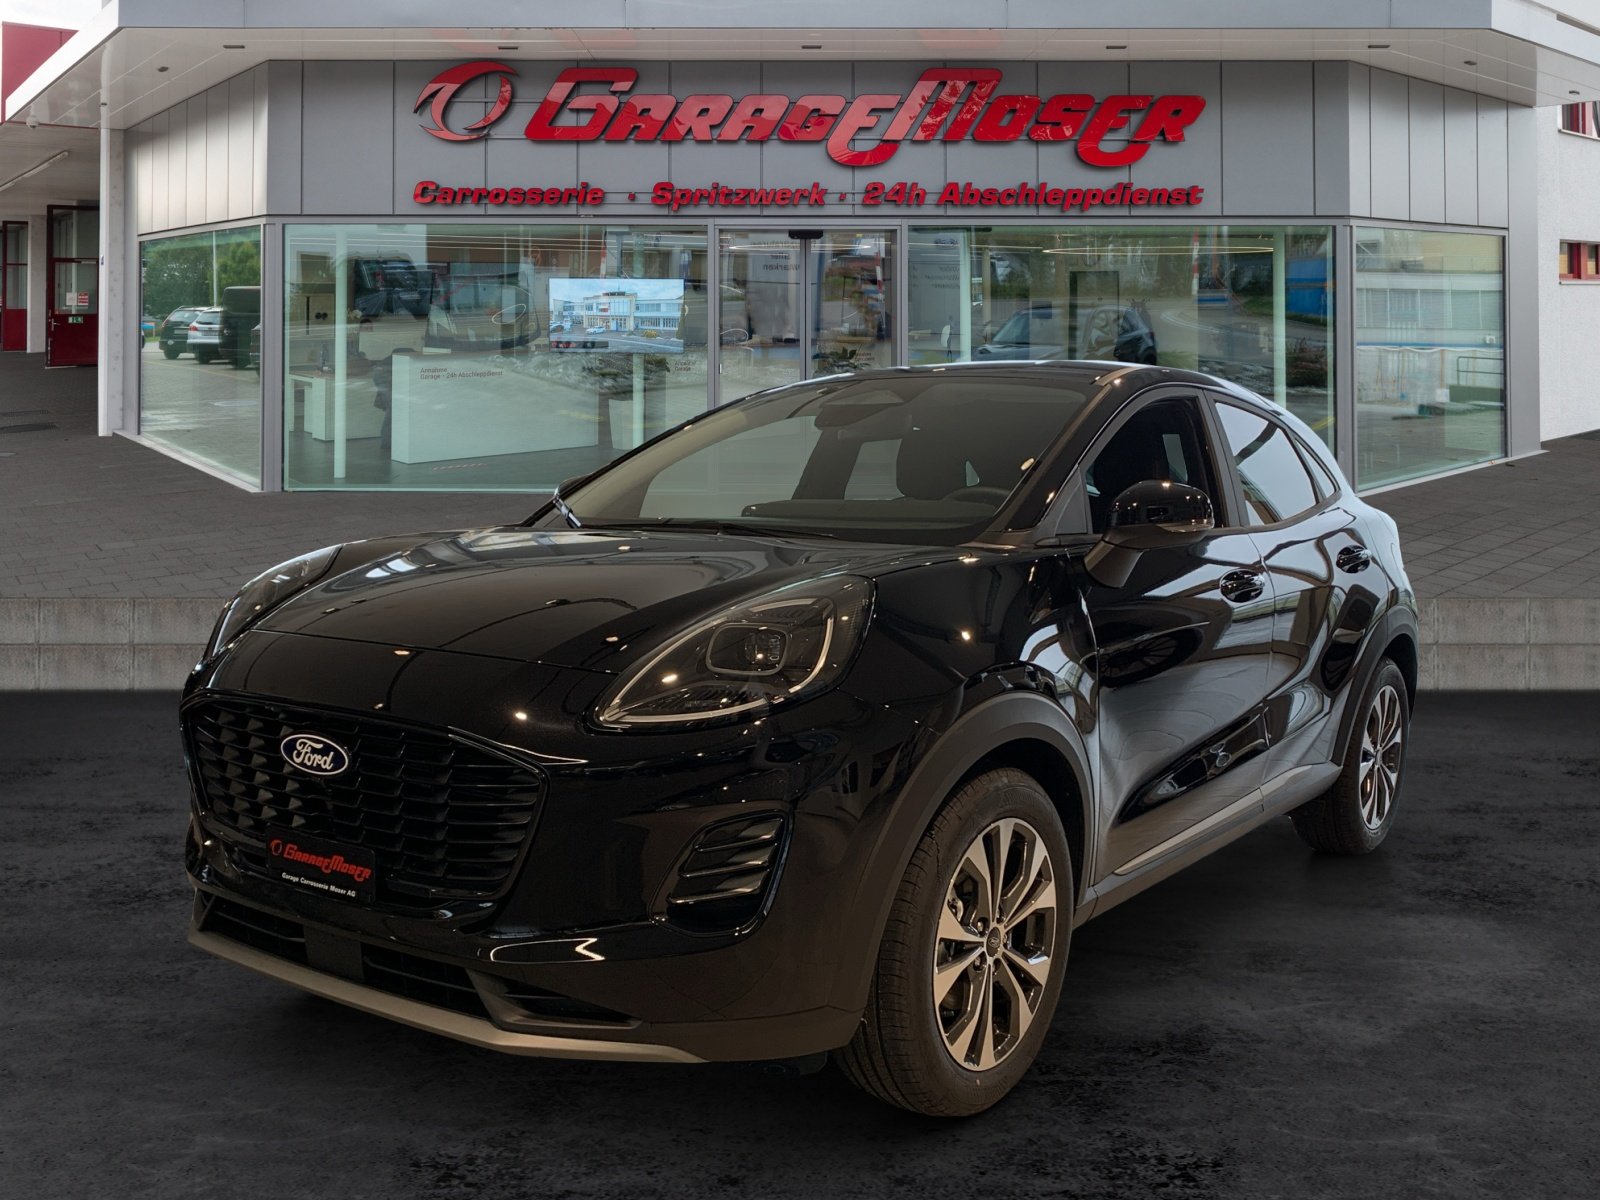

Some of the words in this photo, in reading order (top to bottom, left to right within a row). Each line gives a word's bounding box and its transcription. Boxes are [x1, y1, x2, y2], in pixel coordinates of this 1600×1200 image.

[413, 181, 604, 206] Carrosserie
[651, 181, 826, 210] Spritzwerk
[862, 182, 927, 206] 24h
[936, 182, 1203, 211] Abschleppdienst
[292, 738, 334, 770] Ford
[282, 872, 299, 883] Garage
[300, 877, 329, 890] Carrosserie
[329, 884, 346, 895] Moser
[346, 890, 356, 898] AG
